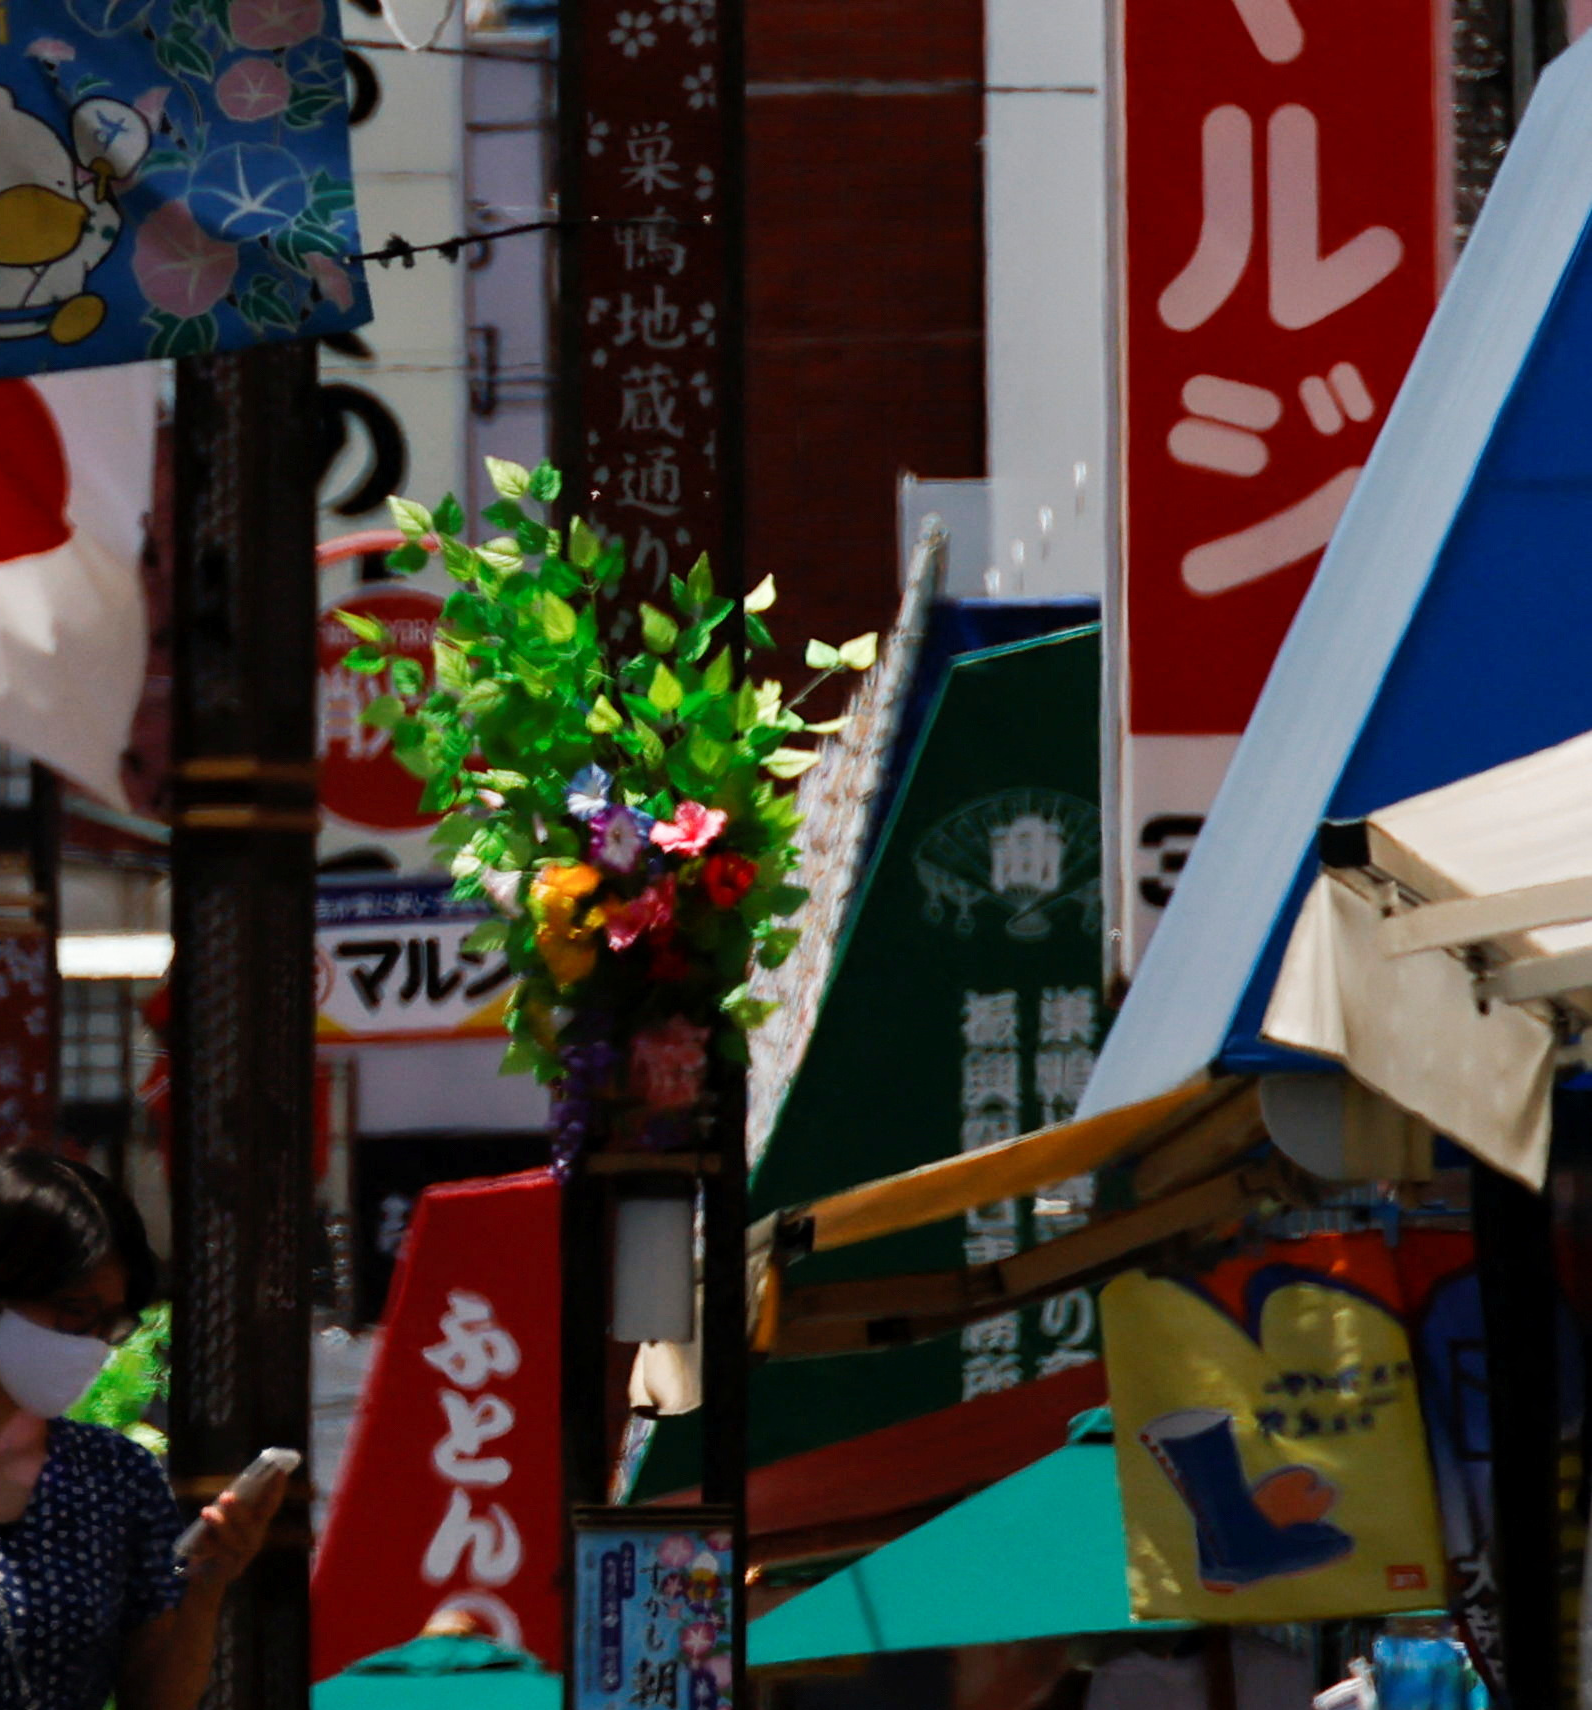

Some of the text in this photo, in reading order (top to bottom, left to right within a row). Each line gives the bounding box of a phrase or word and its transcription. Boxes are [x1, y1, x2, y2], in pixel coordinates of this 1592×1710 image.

[613, 119, 689, 598] 巣鴨地蔵通り
[1158, 0, 1404, 595] ルジ
